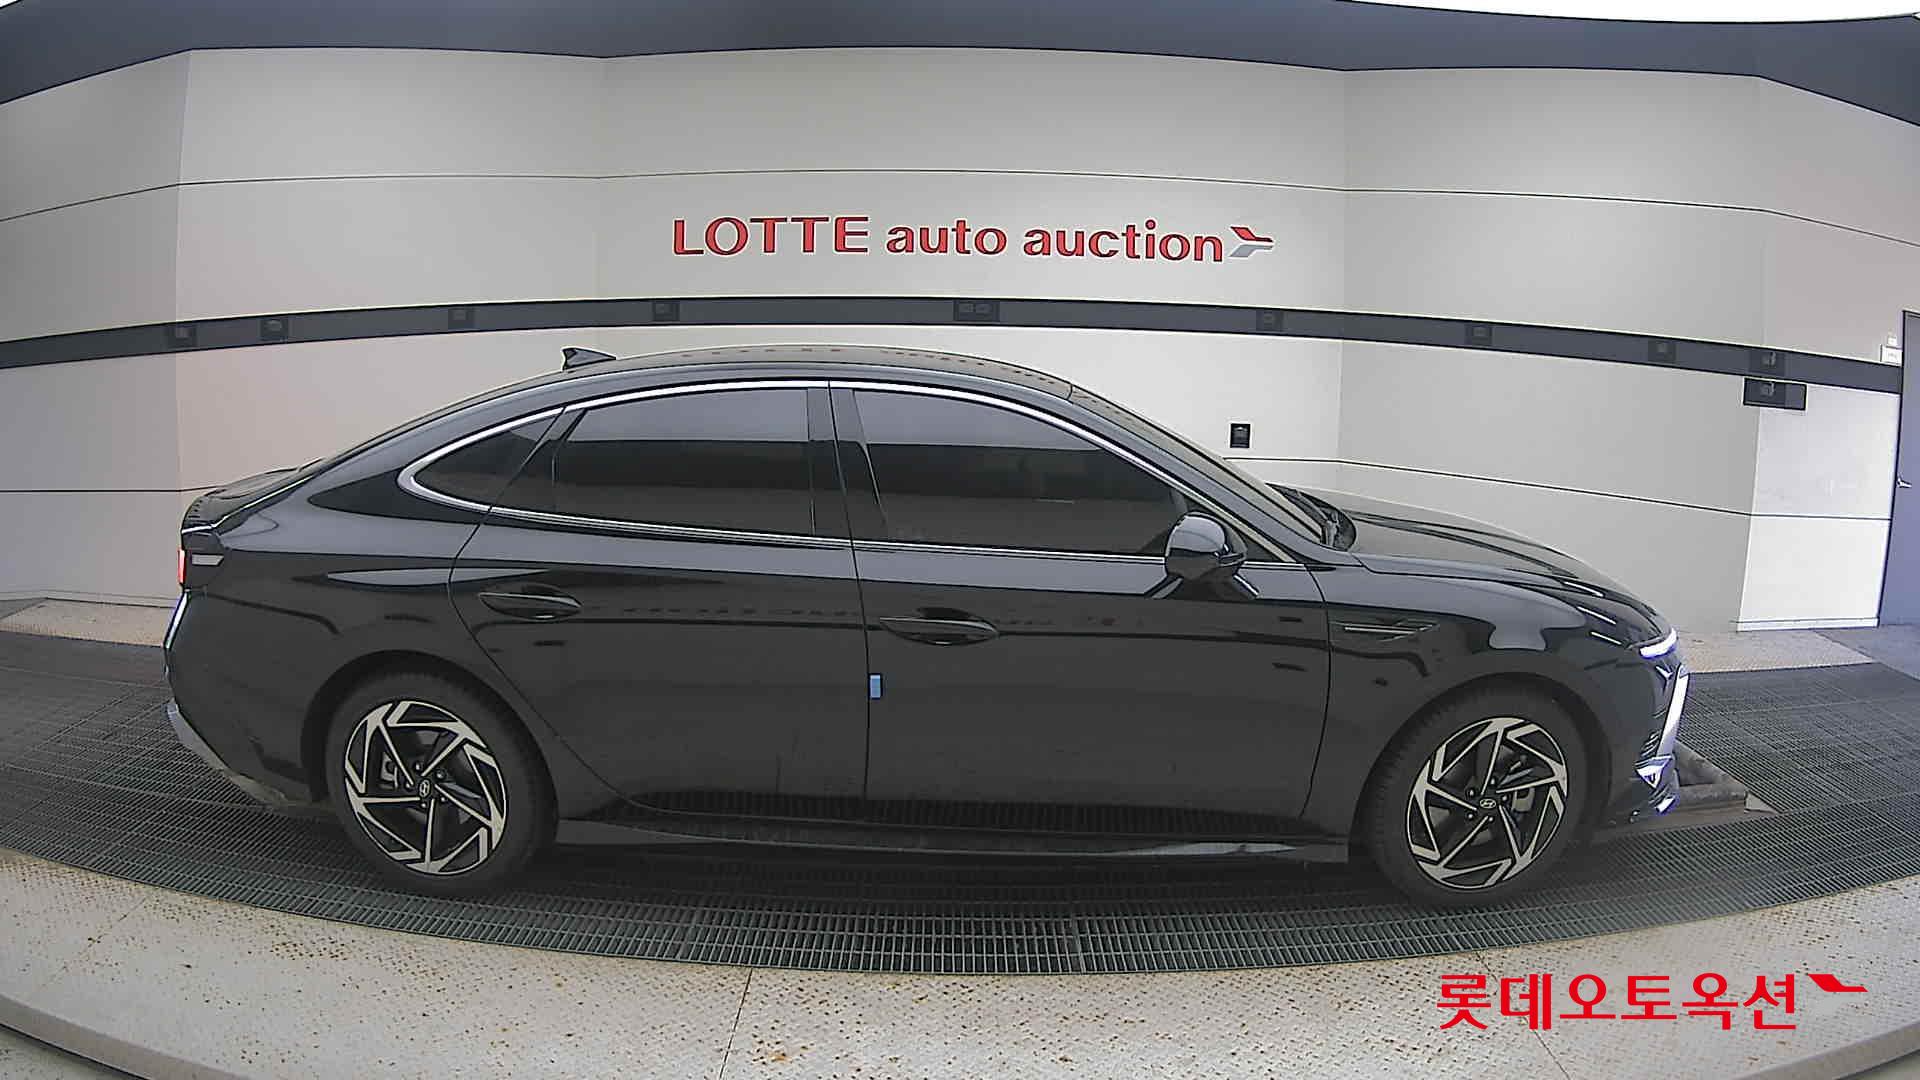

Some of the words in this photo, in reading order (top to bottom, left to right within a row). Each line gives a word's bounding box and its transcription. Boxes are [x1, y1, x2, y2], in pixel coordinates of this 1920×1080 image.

[673, 216, 869, 256] LOTTE
[886, 219, 1008, 255] auto
[1023, 219, 1223, 262] auction
